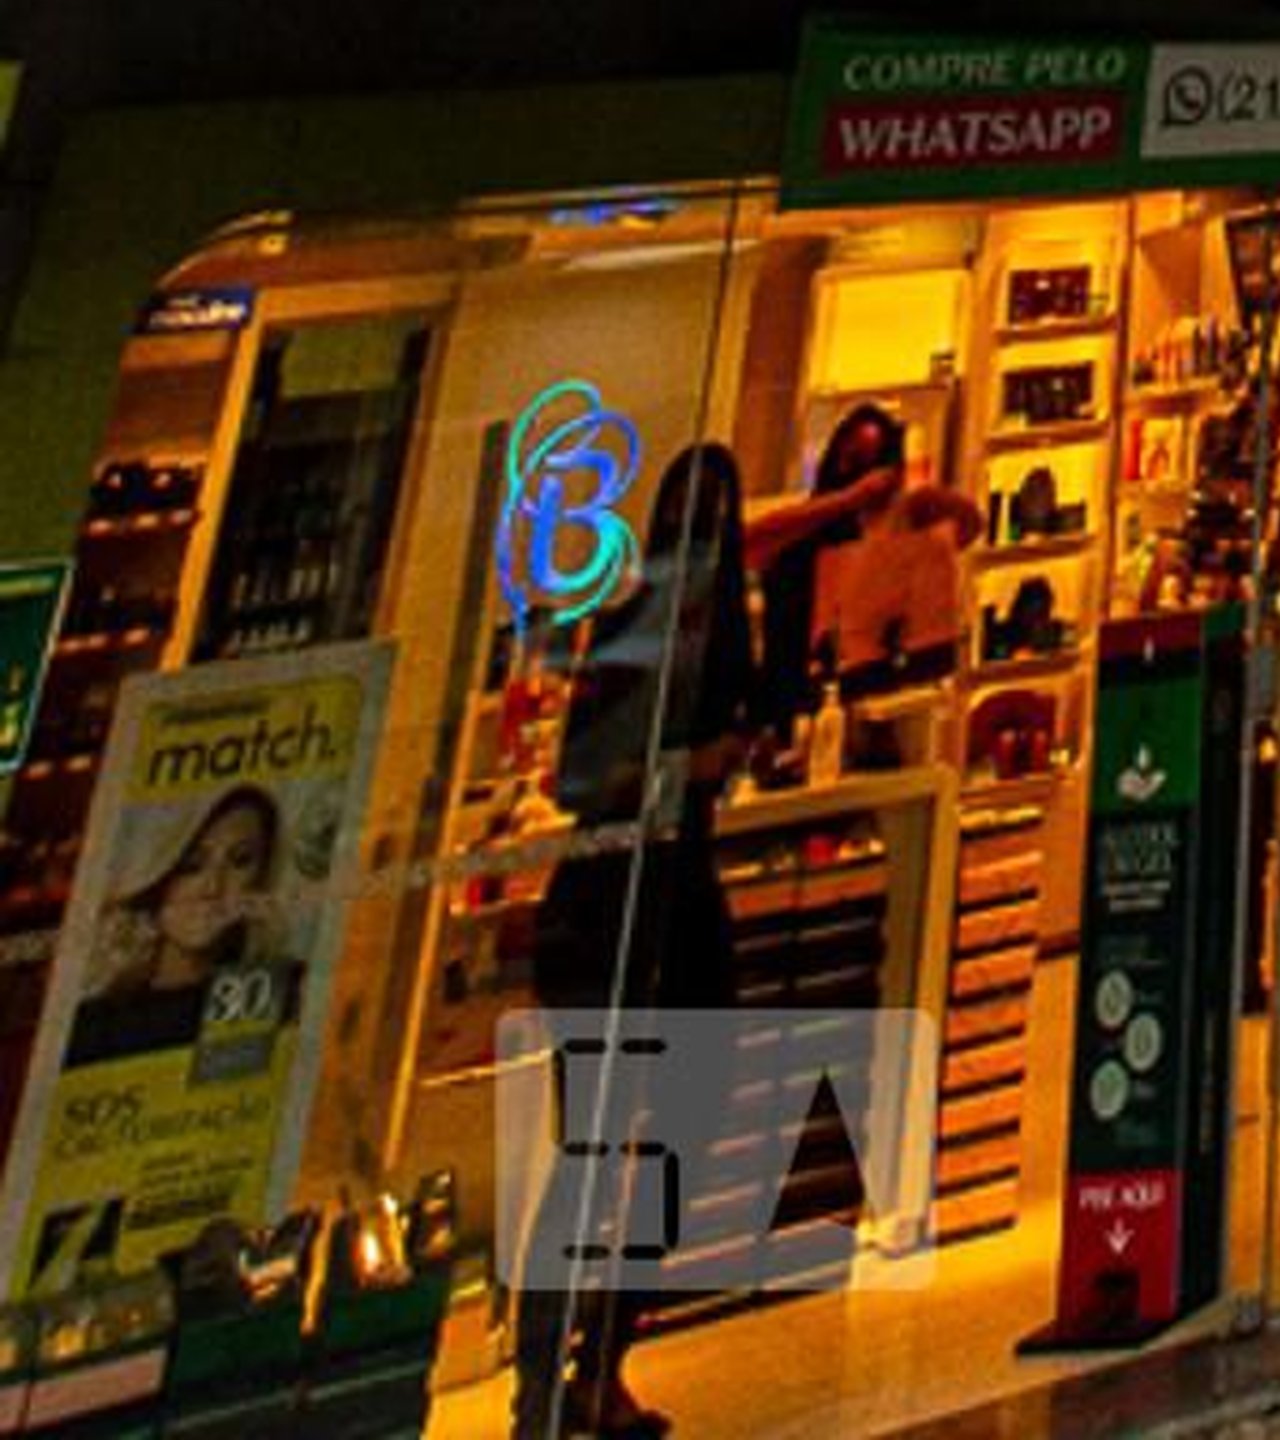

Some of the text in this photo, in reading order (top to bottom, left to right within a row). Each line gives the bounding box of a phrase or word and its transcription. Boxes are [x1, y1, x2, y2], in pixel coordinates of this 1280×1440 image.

[843, 46, 1128, 91] COMPRE PELO
[838, 105, 1112, 159] WHATSAPP
